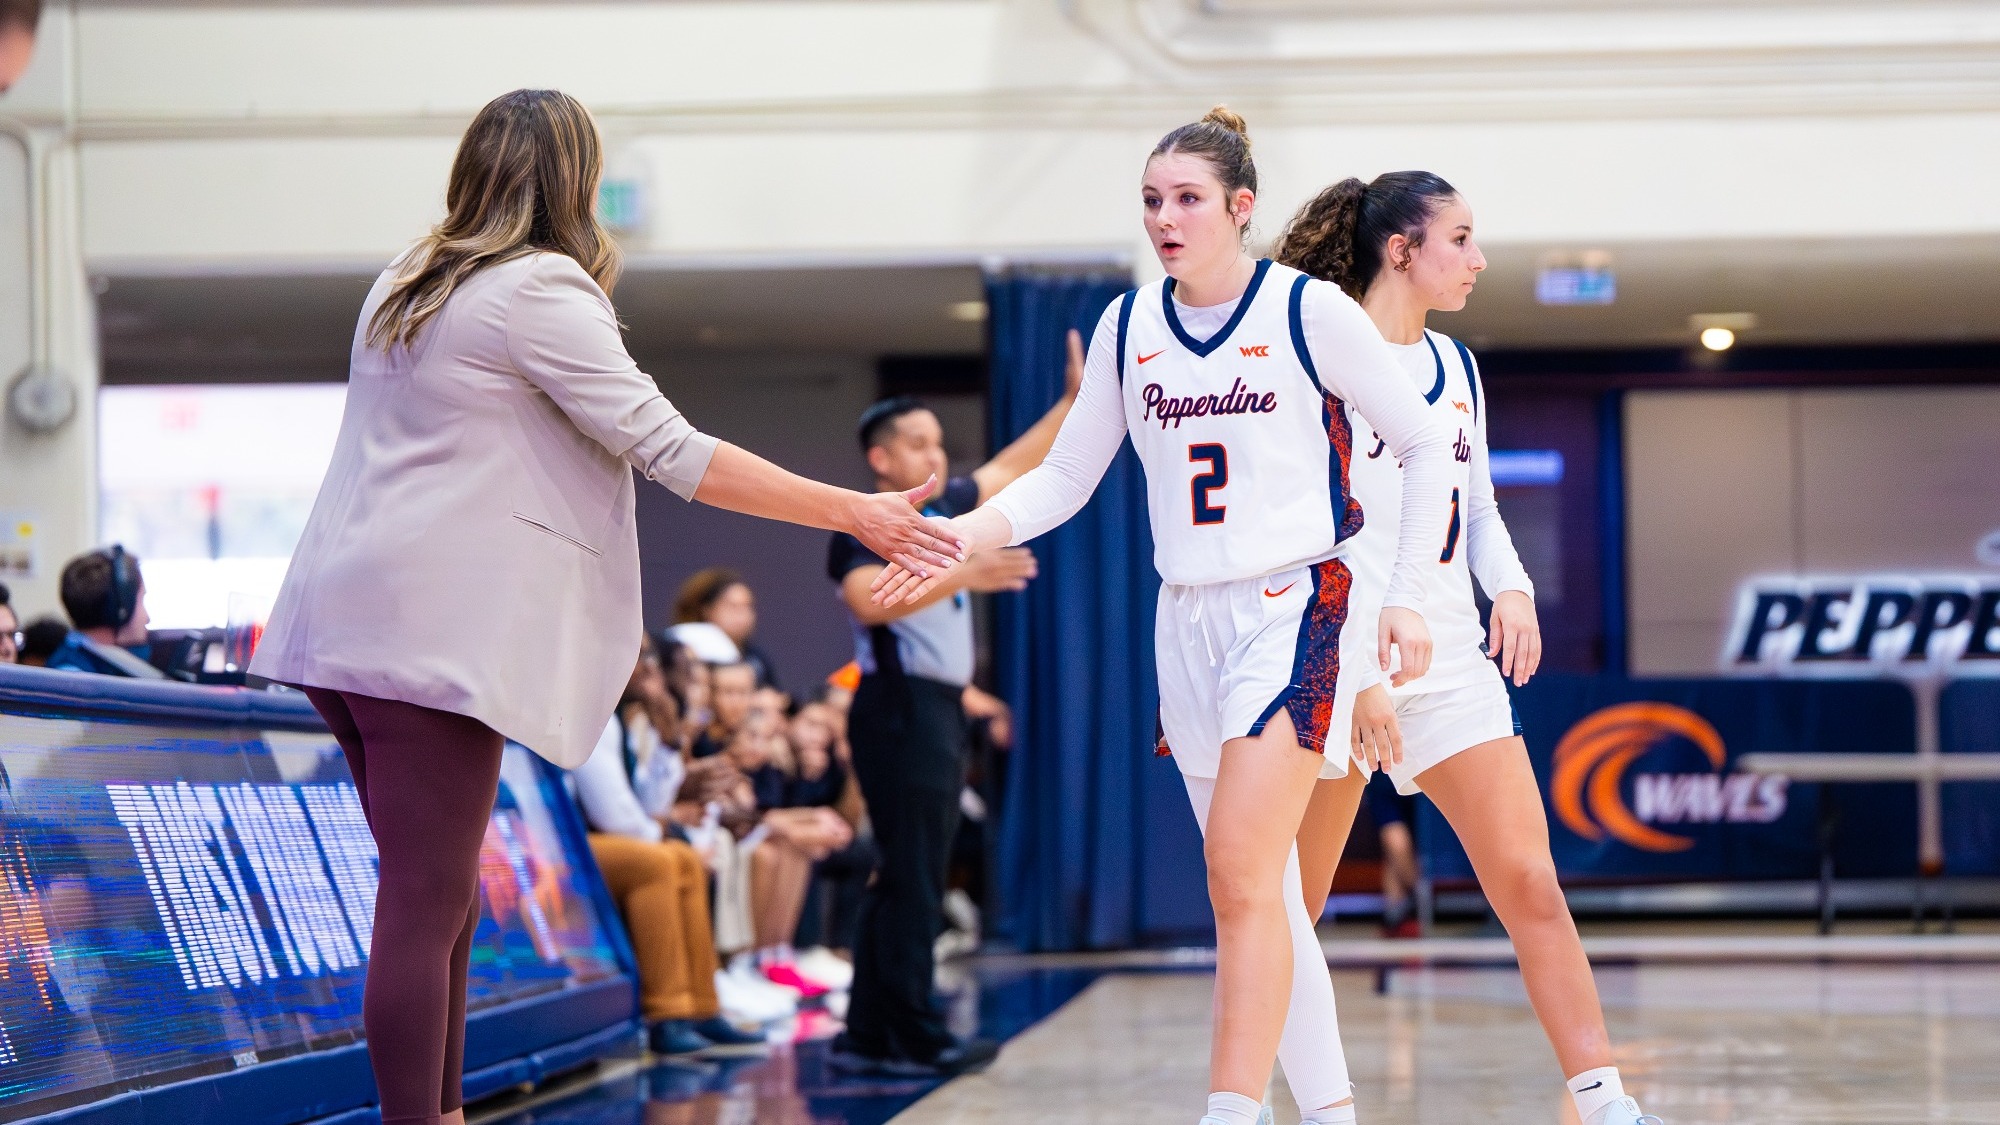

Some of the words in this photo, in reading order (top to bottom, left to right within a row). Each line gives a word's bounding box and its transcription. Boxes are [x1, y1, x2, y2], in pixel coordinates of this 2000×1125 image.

[1238, 345, 1270, 358] WCC
[1142, 376, 1278, 430] Pepperdine
[1188, 442, 1229, 526] 2
